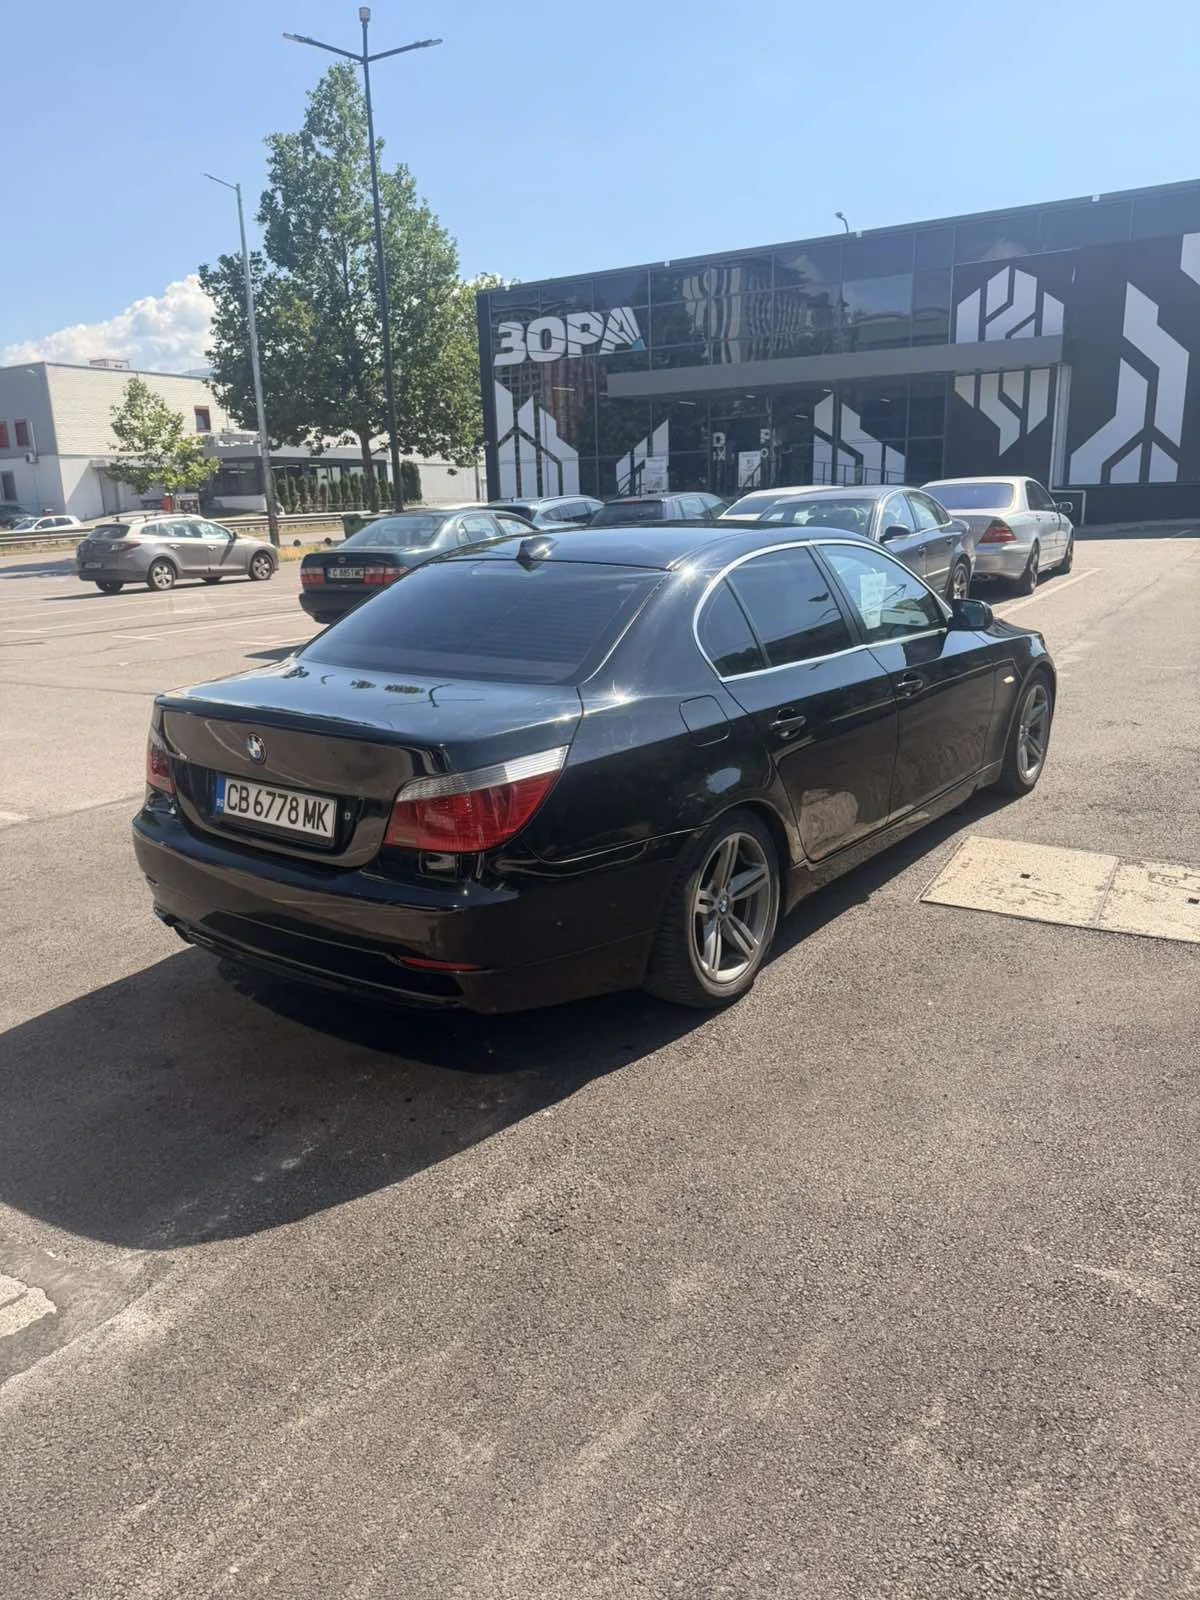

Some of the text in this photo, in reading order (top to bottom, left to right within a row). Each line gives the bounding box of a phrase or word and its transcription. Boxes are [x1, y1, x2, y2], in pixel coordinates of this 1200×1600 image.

[494, 306, 646, 366] ЗОРА
[227, 783, 330, 833] CB 6778 MK
